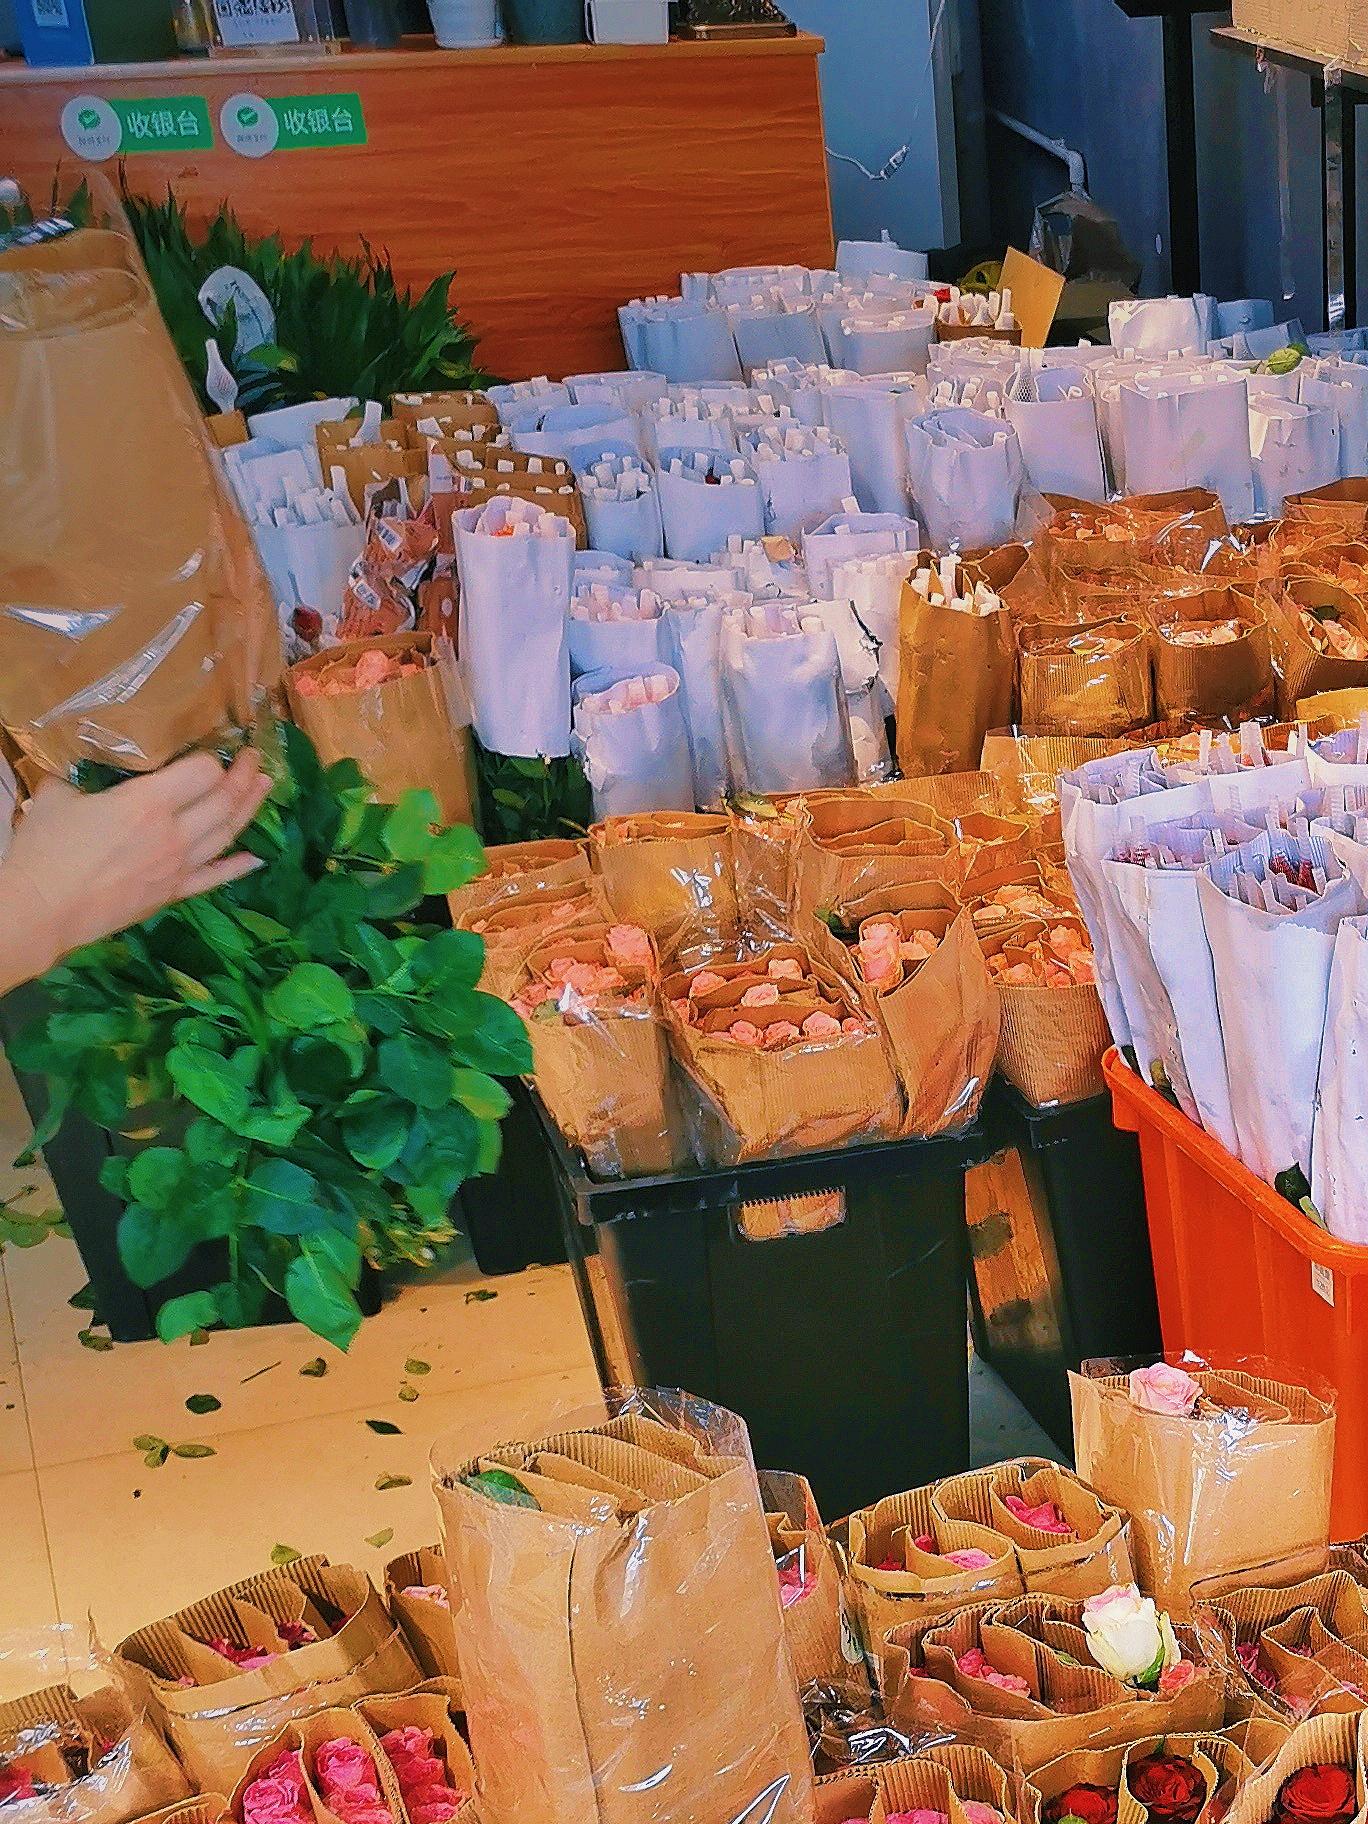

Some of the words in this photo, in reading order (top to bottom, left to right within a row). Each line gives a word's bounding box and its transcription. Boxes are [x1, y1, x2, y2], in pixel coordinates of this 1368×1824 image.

[127, 108, 199, 138] 收银台
[283, 106, 354, 137] 收银台
